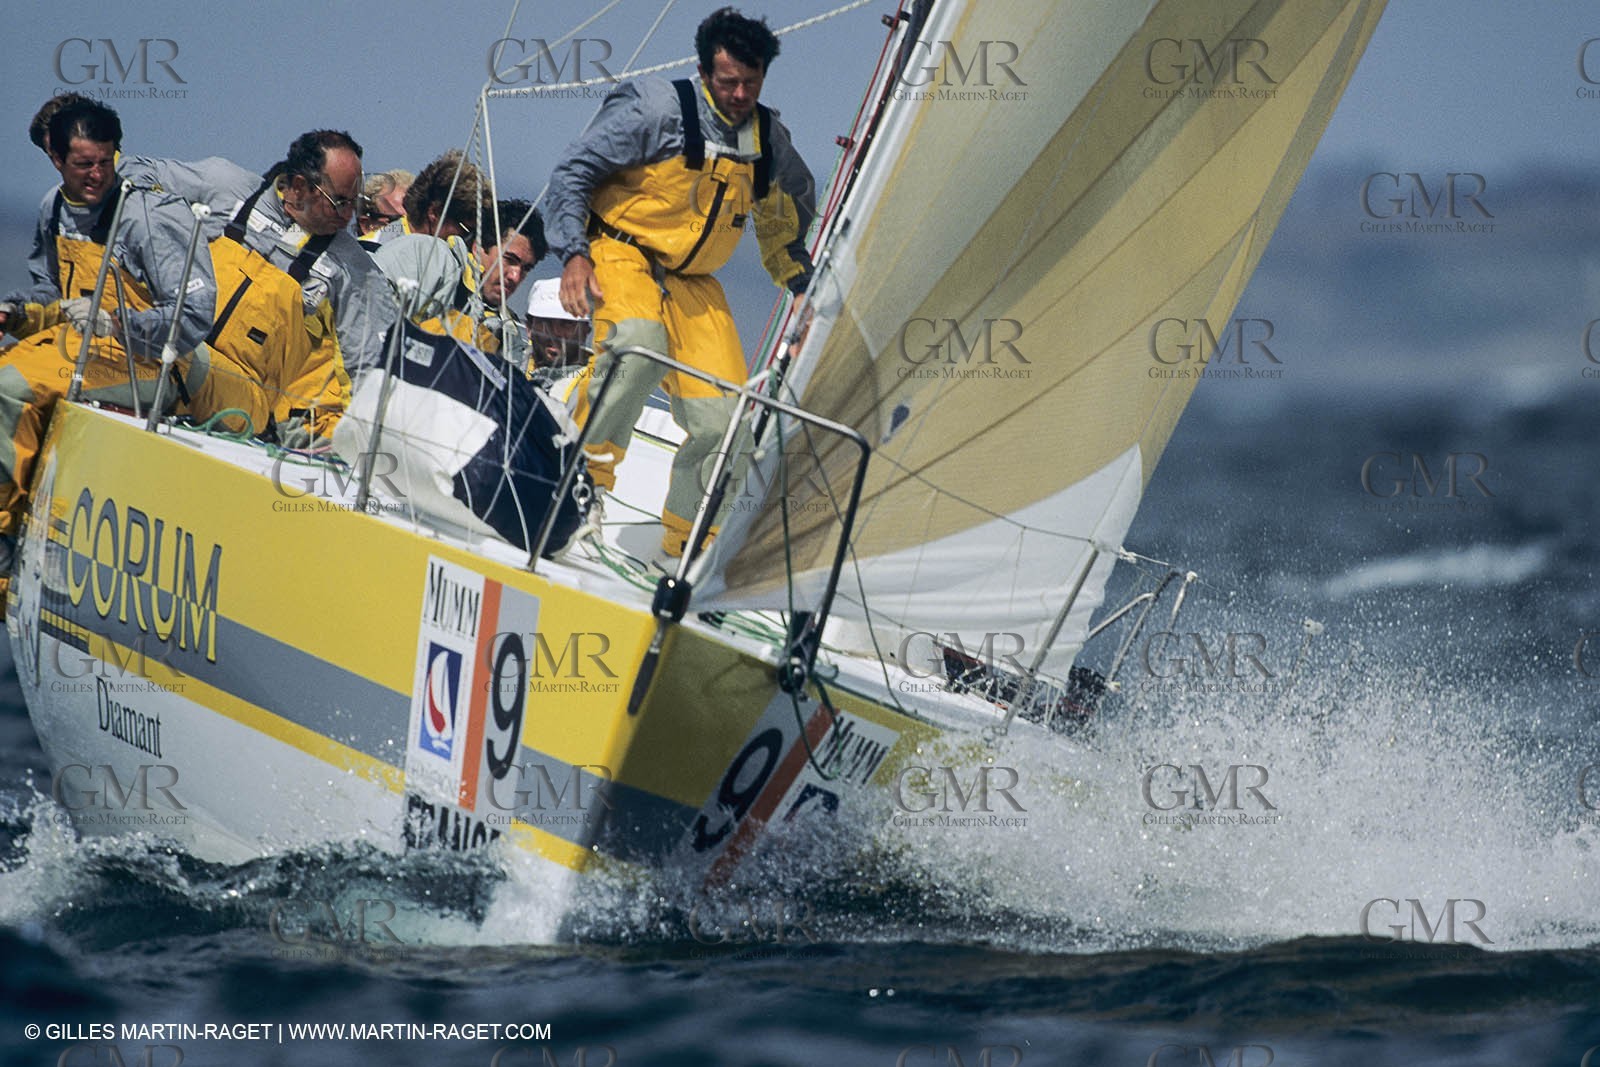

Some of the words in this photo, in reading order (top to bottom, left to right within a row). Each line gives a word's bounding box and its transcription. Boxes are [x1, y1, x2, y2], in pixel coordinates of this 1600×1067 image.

[67, 487, 222, 664] CORUM
[96, 675, 162, 759] Diamant
[487, 632, 526, 780] 9
[692, 728, 783, 852] 9
